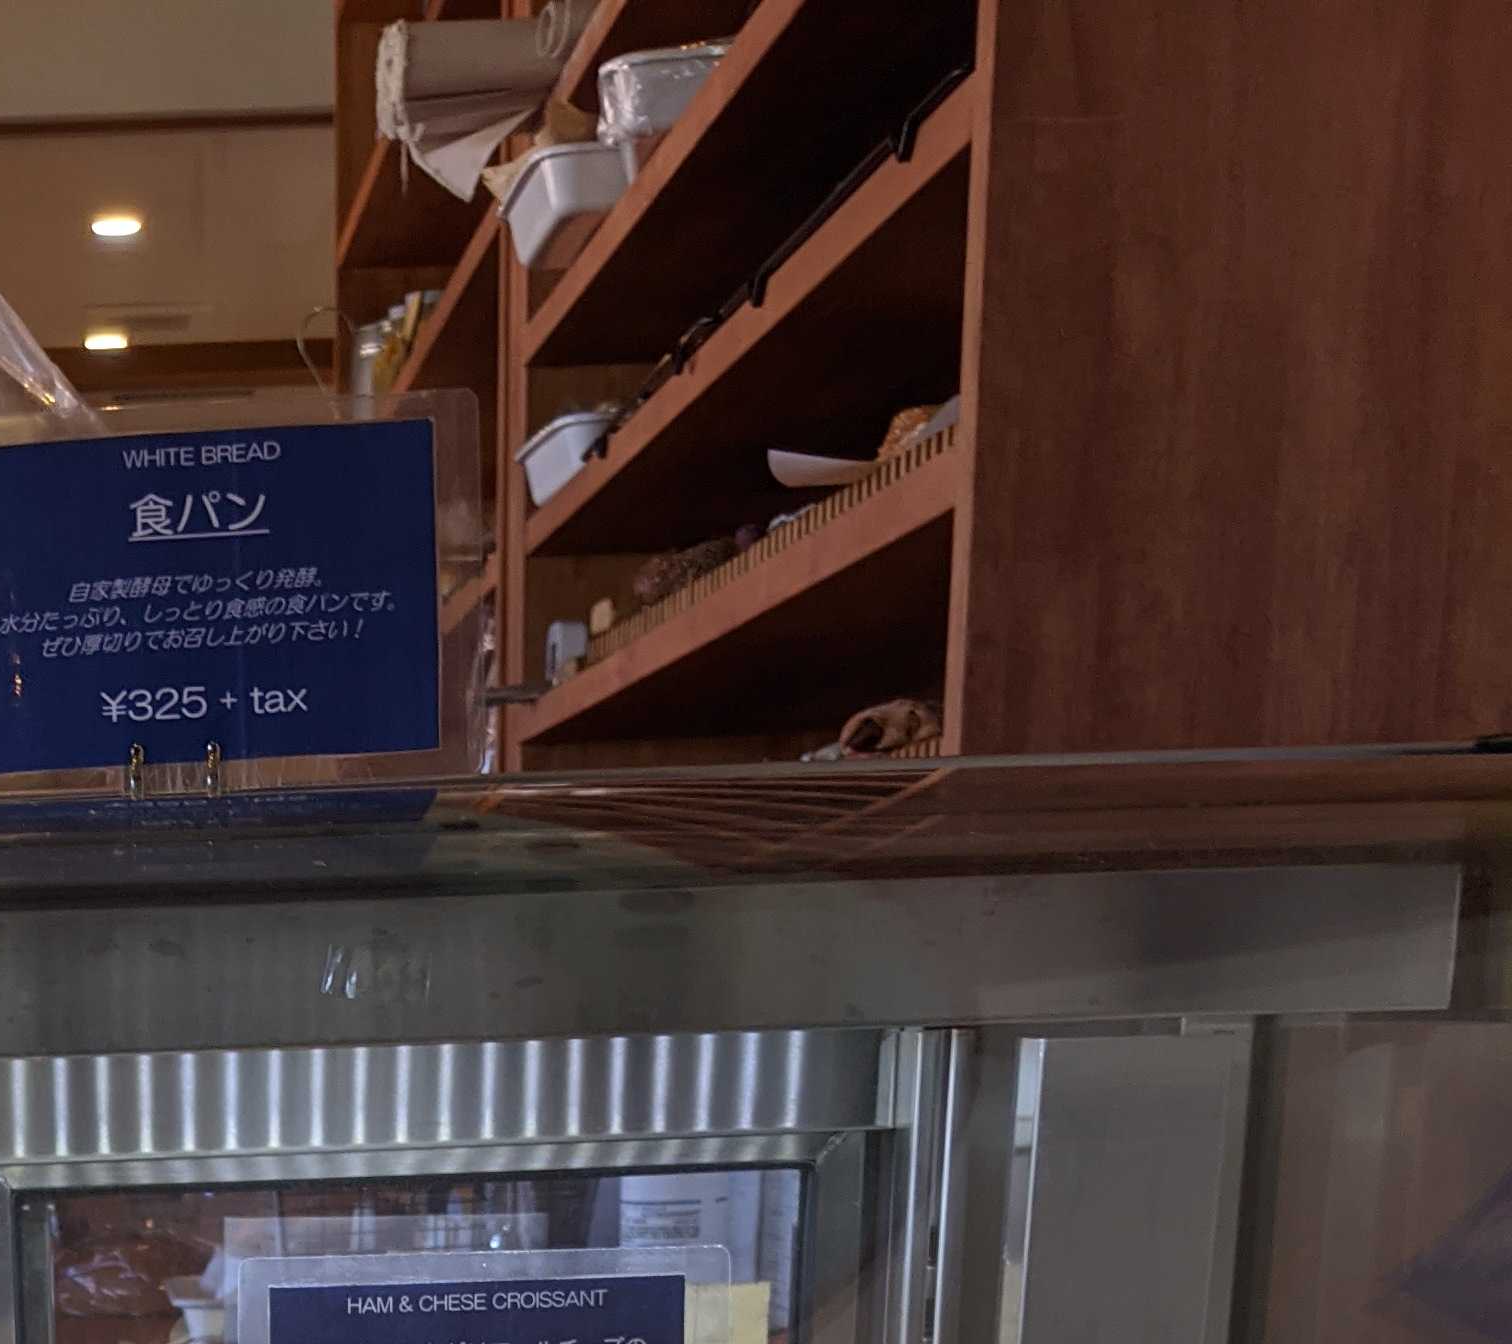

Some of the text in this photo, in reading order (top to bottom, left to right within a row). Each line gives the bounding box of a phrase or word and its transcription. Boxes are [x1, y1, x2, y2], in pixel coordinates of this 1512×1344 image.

[123, 441, 280, 468] WHITE BREAD
[129, 491, 266, 536] 食パン
[101, 686, 308, 722] ¥325 + tax
[348, 1289, 607, 1314] HAM & CHESE CROISSANT
